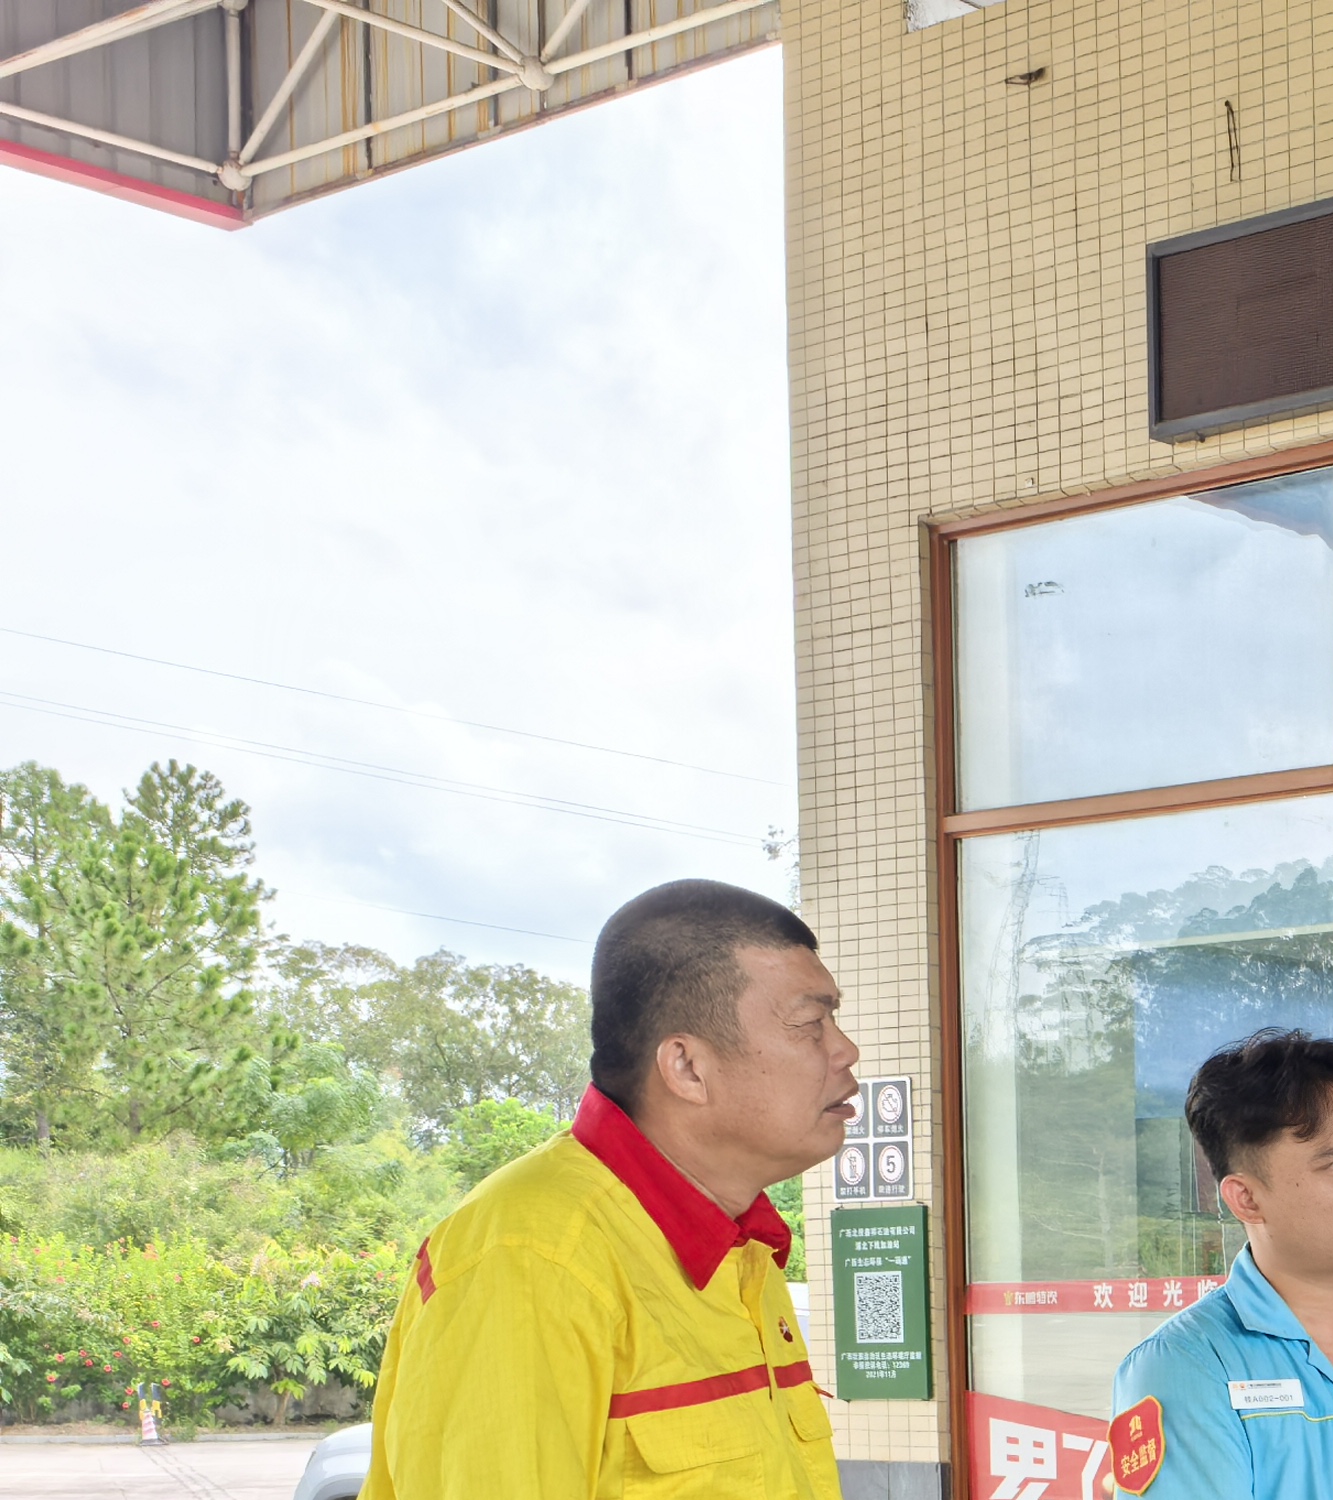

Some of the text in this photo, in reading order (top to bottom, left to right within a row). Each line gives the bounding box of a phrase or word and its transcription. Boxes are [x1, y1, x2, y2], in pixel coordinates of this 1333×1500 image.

[886, 1155, 896, 1173] 5
[1121, 1438, 1157, 1479] 安全监督
